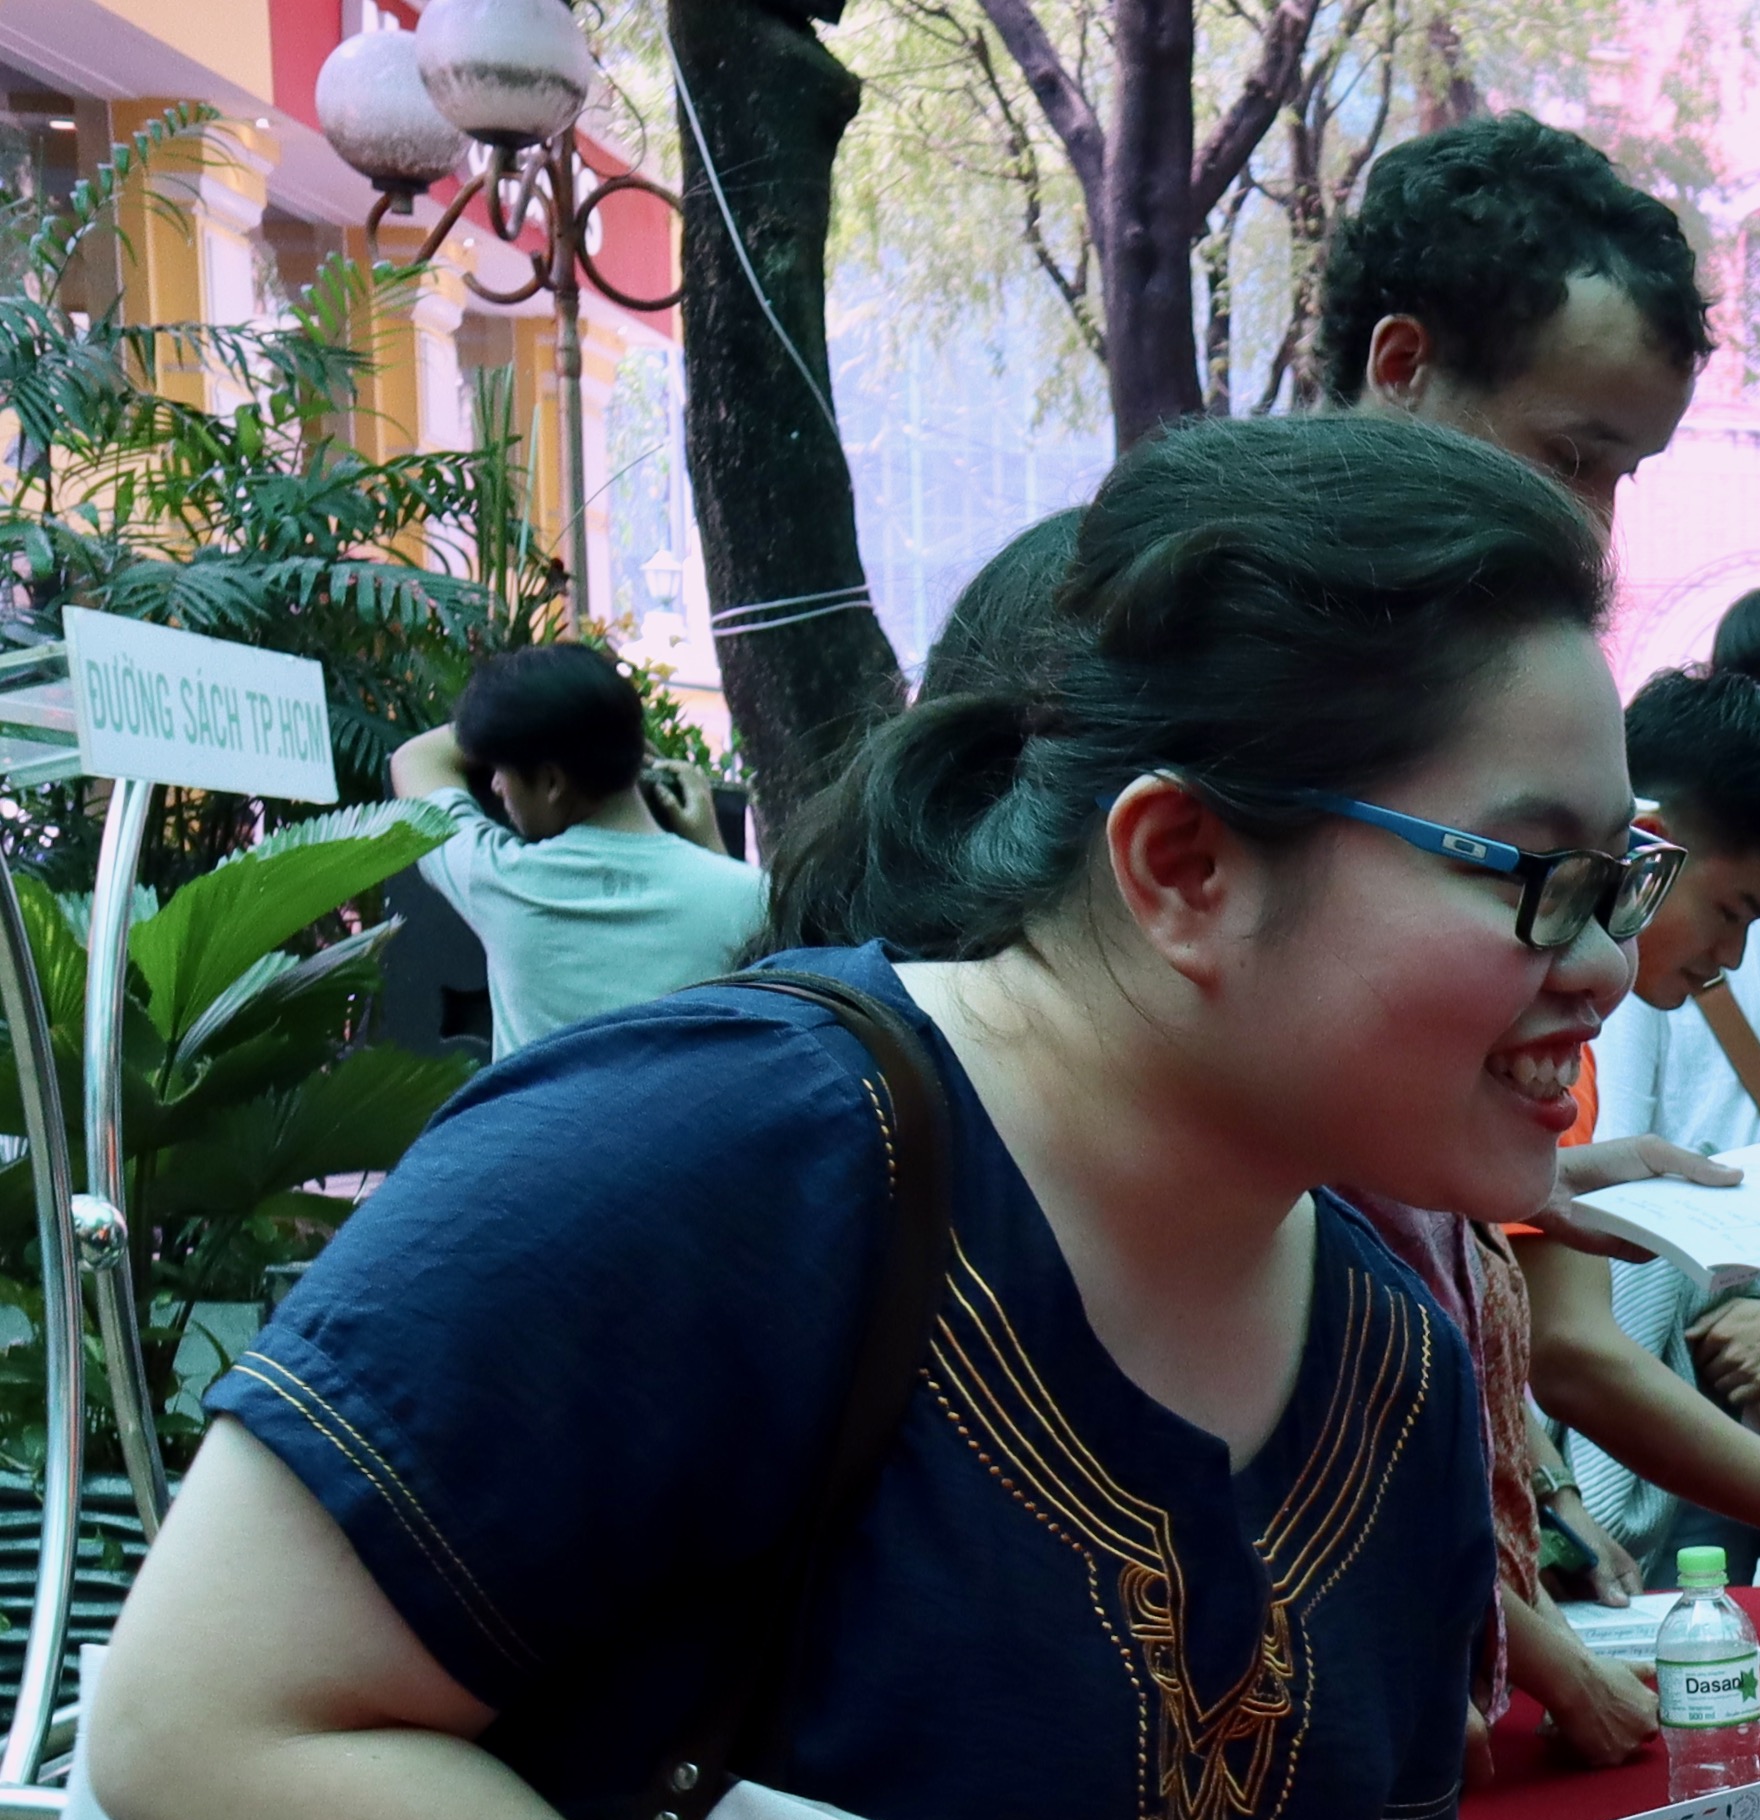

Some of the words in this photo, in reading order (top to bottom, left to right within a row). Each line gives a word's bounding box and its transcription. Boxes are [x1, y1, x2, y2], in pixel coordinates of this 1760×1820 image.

[86, 652, 174, 740] ĐƯỜNG
[180, 666, 242, 750] SÁCH
[245, 690, 327, 764] TP.HCM
